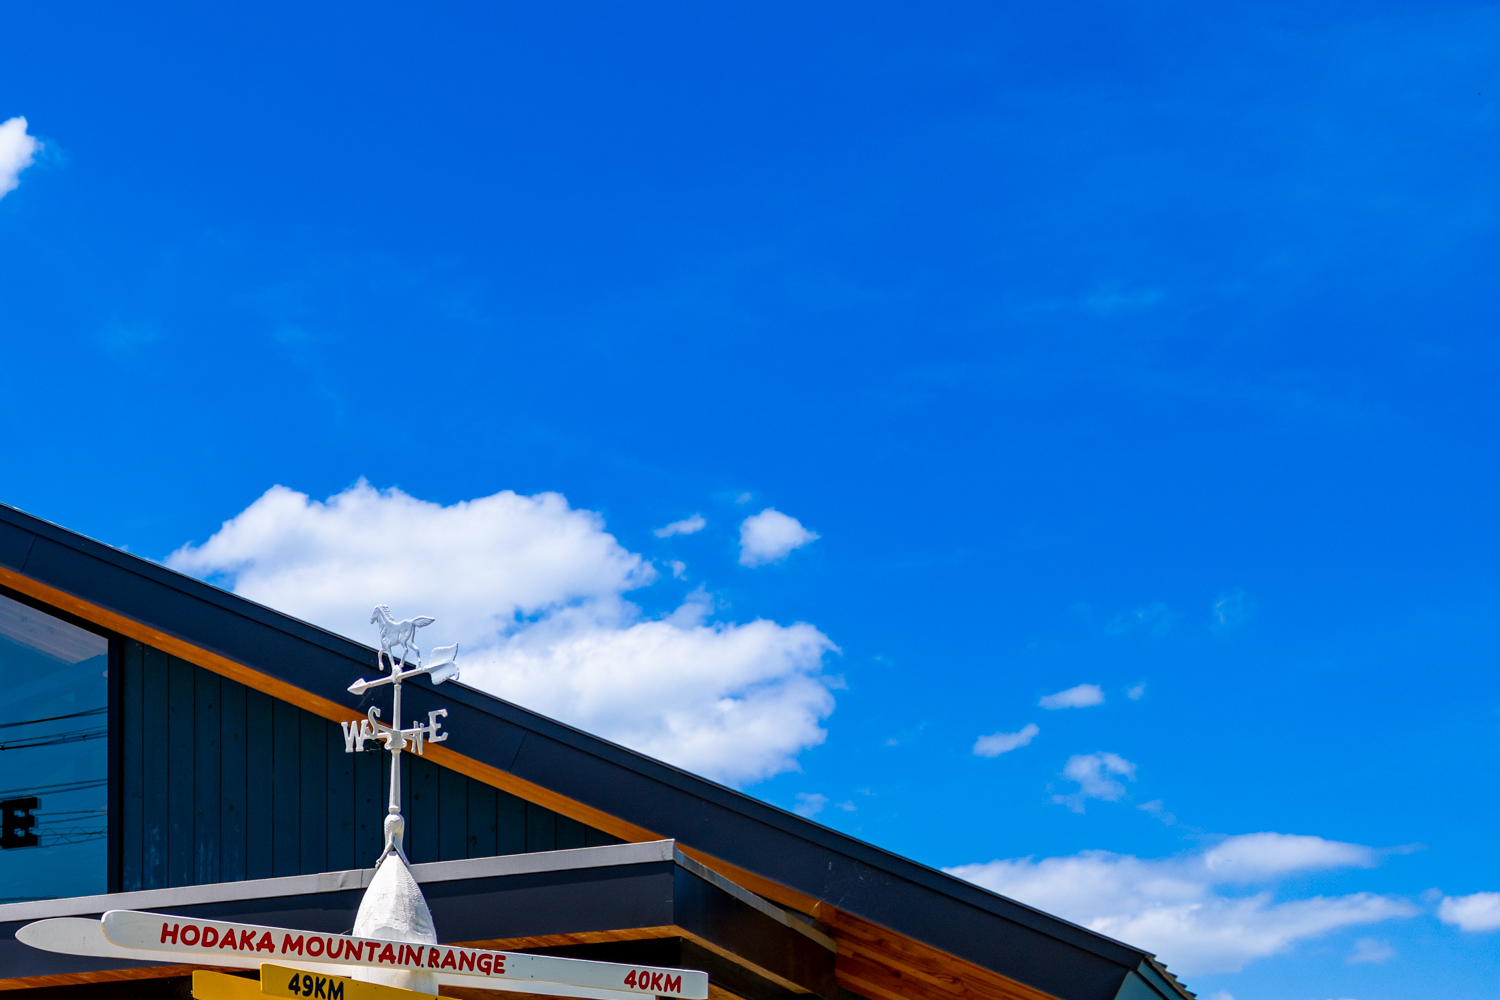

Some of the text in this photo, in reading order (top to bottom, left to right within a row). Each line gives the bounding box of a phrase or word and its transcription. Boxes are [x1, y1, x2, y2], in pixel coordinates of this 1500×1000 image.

[160, 922, 682, 994] HODAKA MOUNTAIN RANGE 40KM
